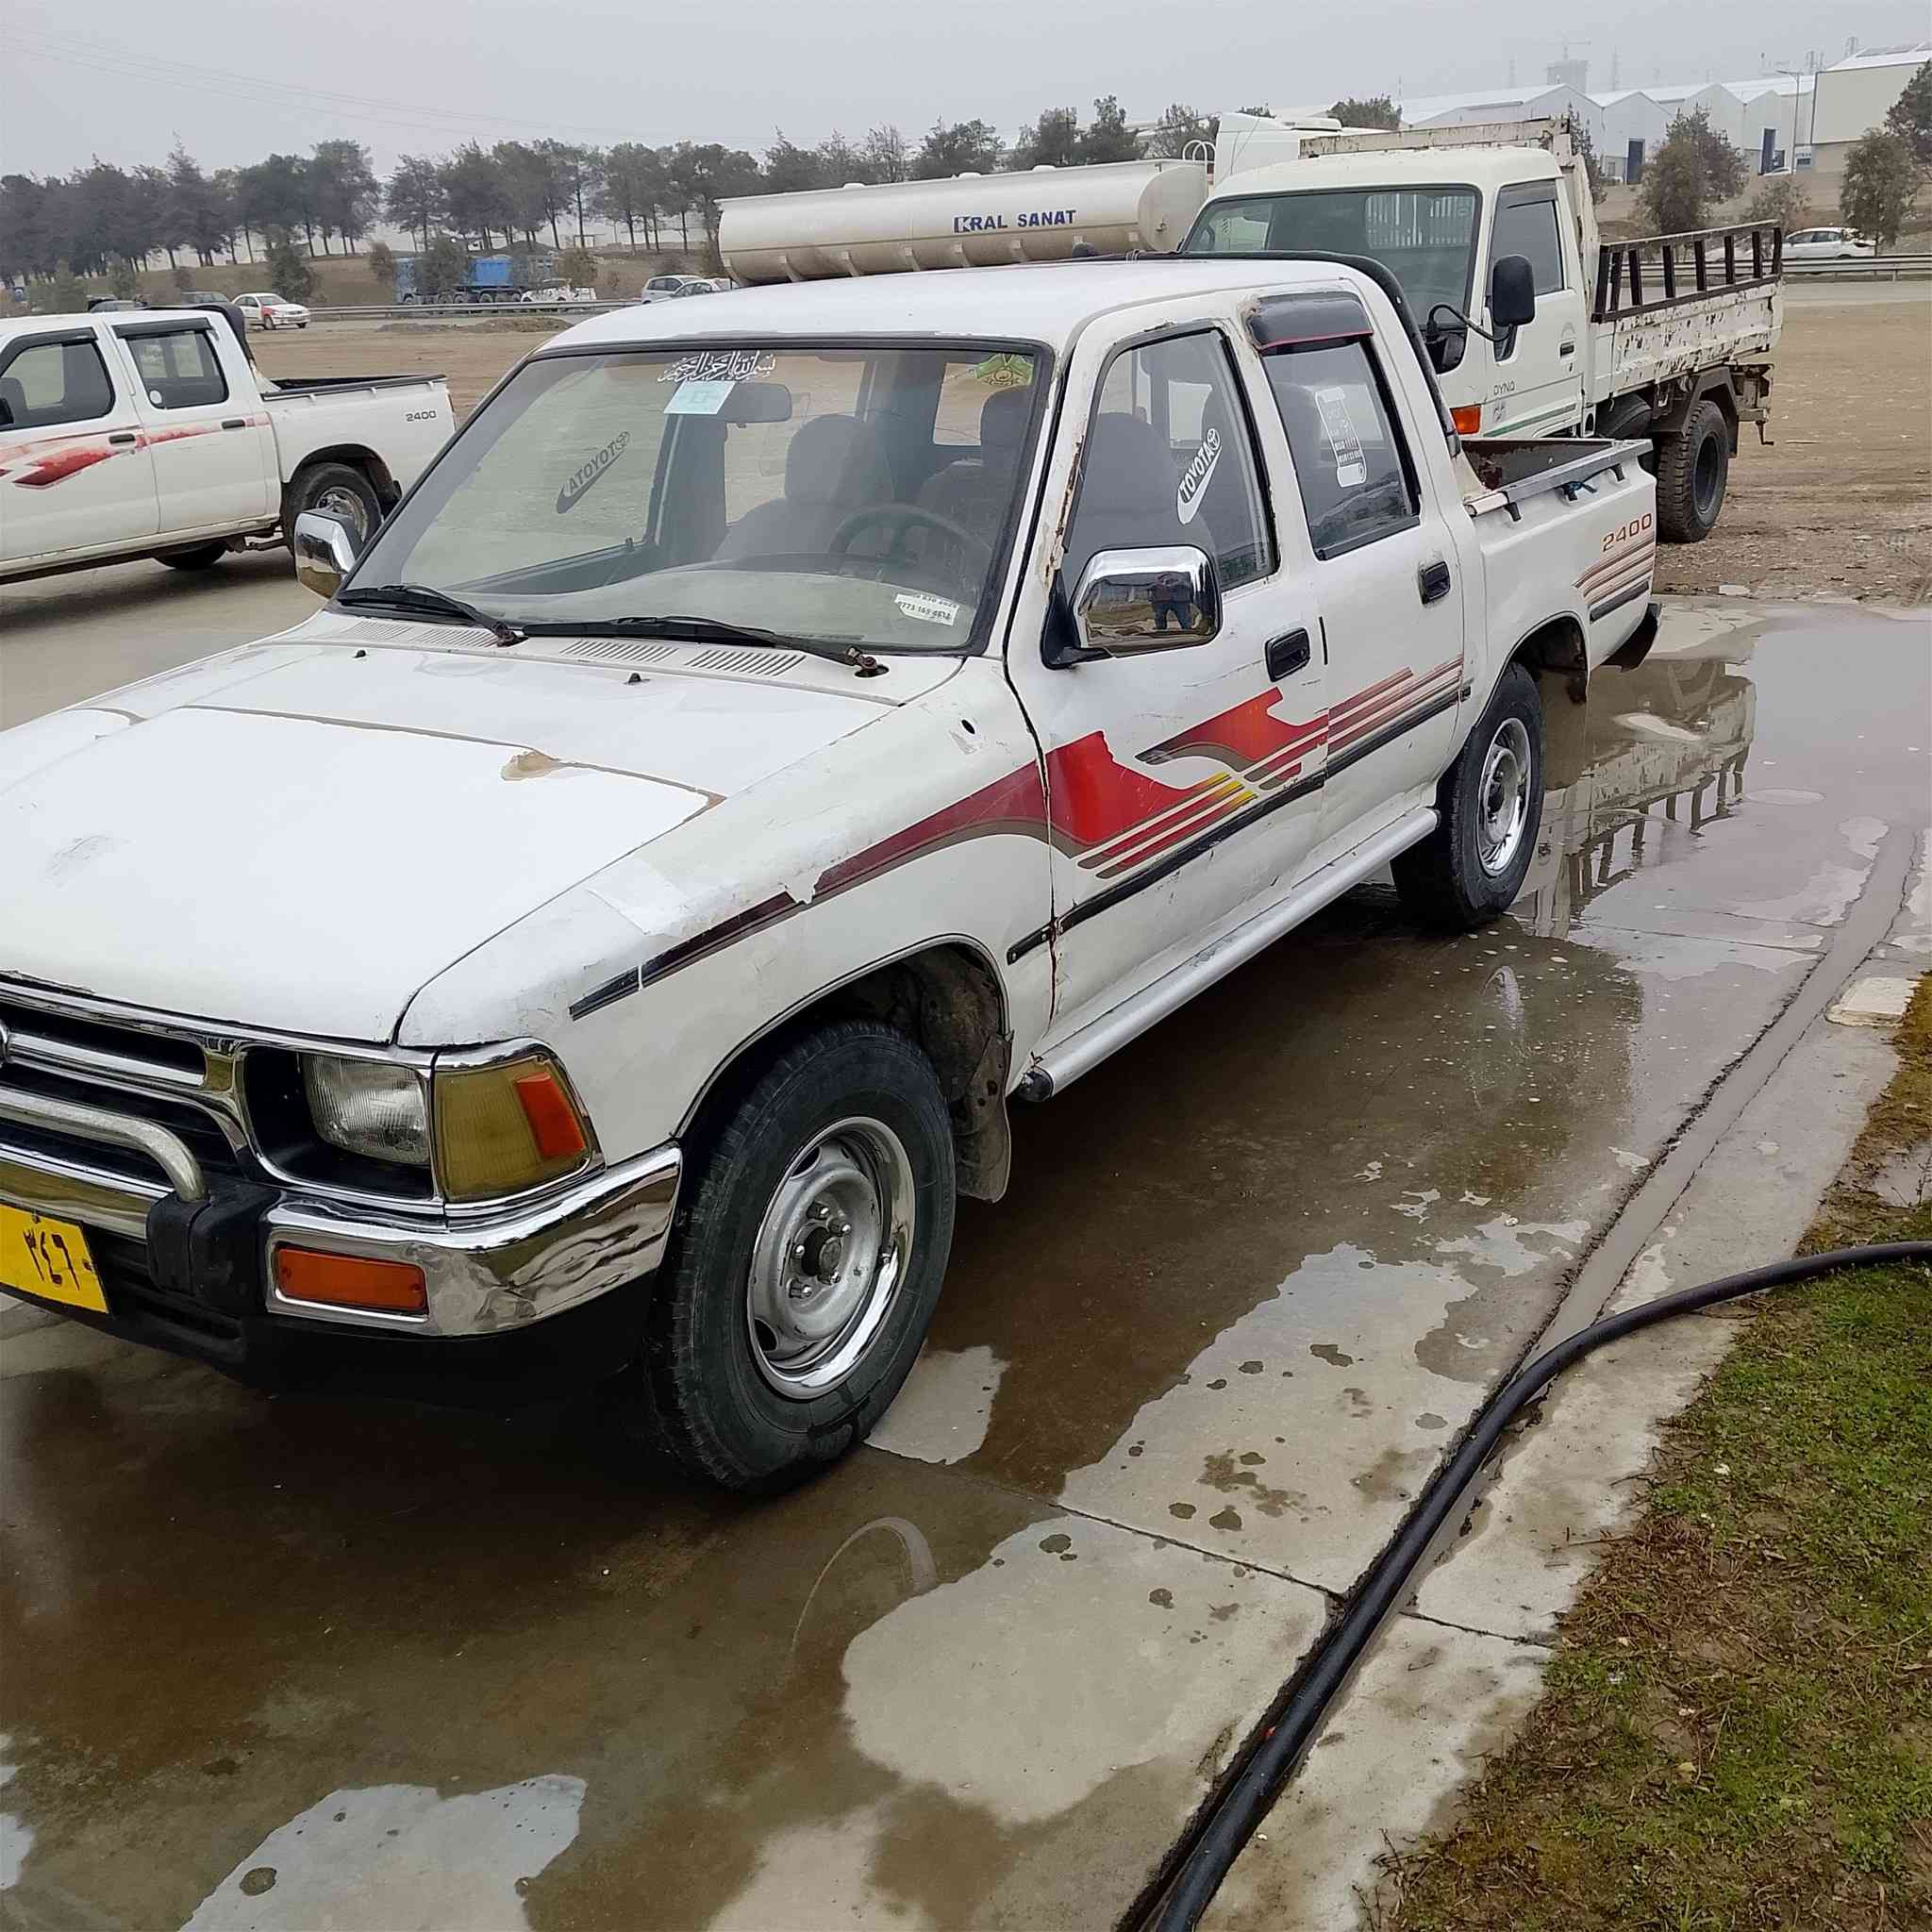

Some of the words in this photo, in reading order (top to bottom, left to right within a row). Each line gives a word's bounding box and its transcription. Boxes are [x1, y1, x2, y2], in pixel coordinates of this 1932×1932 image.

[954, 215, 1008, 234] KRAL
[1017, 208, 1077, 228] SANAT
[405, 409, 437, 423] 2400
[1179, 441, 1215, 500] TOYOTA
[1602, 512, 1653, 553] 2400
